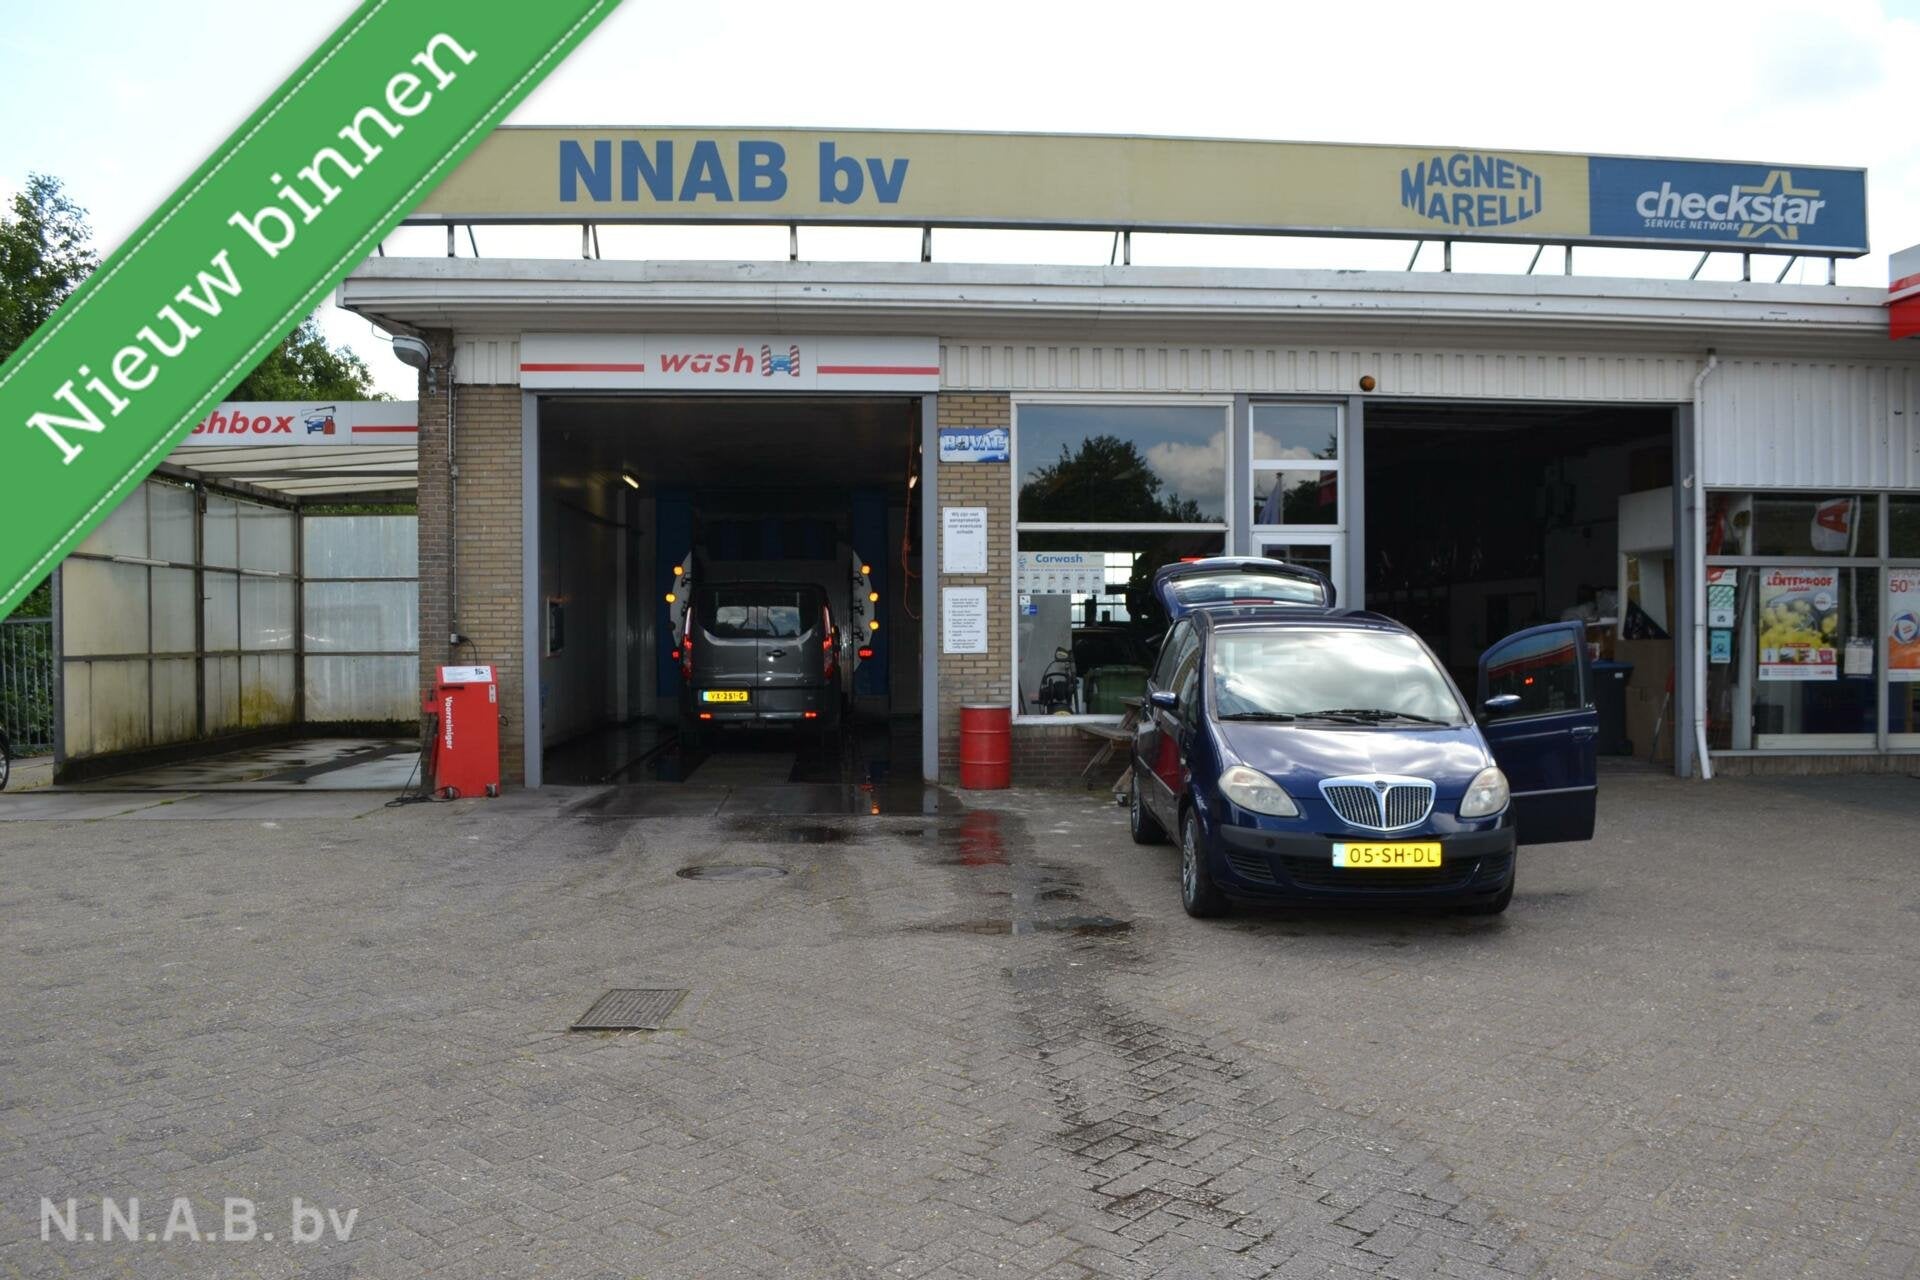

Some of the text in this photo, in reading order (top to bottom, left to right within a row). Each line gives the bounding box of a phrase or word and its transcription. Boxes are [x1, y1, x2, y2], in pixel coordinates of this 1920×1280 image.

[559, 140, 909, 204] NNAB bv
[1401, 154, 1541, 200] MAGNETI
[1401, 178, 1541, 227] MARELLI
[1636, 182, 1826, 225] checkstar
[1644, 218, 1740, 231] SERVICE NETWORK
[660, 347, 754, 373] wash
[1035, 554, 1083, 563] Carwash
[1350, 848, 1435, 863] 05-SH-DL
